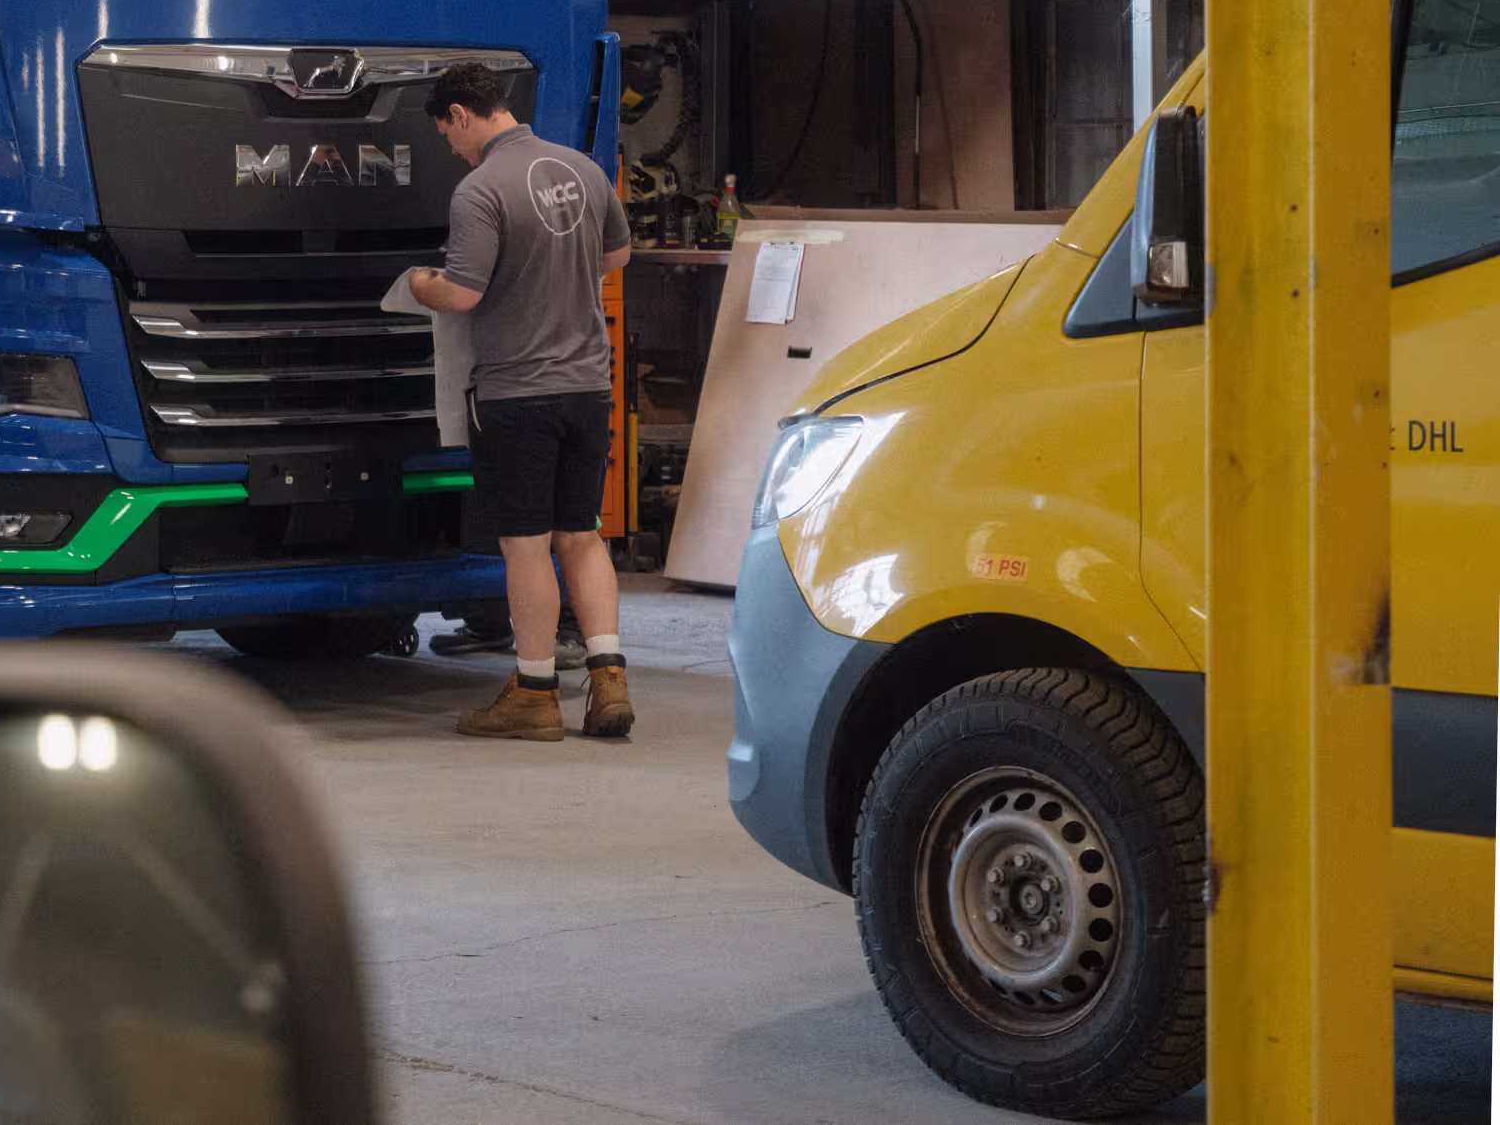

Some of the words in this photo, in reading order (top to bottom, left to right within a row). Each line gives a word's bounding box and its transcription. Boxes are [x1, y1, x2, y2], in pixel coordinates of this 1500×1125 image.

[235, 144, 411, 187] MAN
[1408, 420, 1464, 453] DHL
[997, 559, 1026, 577] PSI
